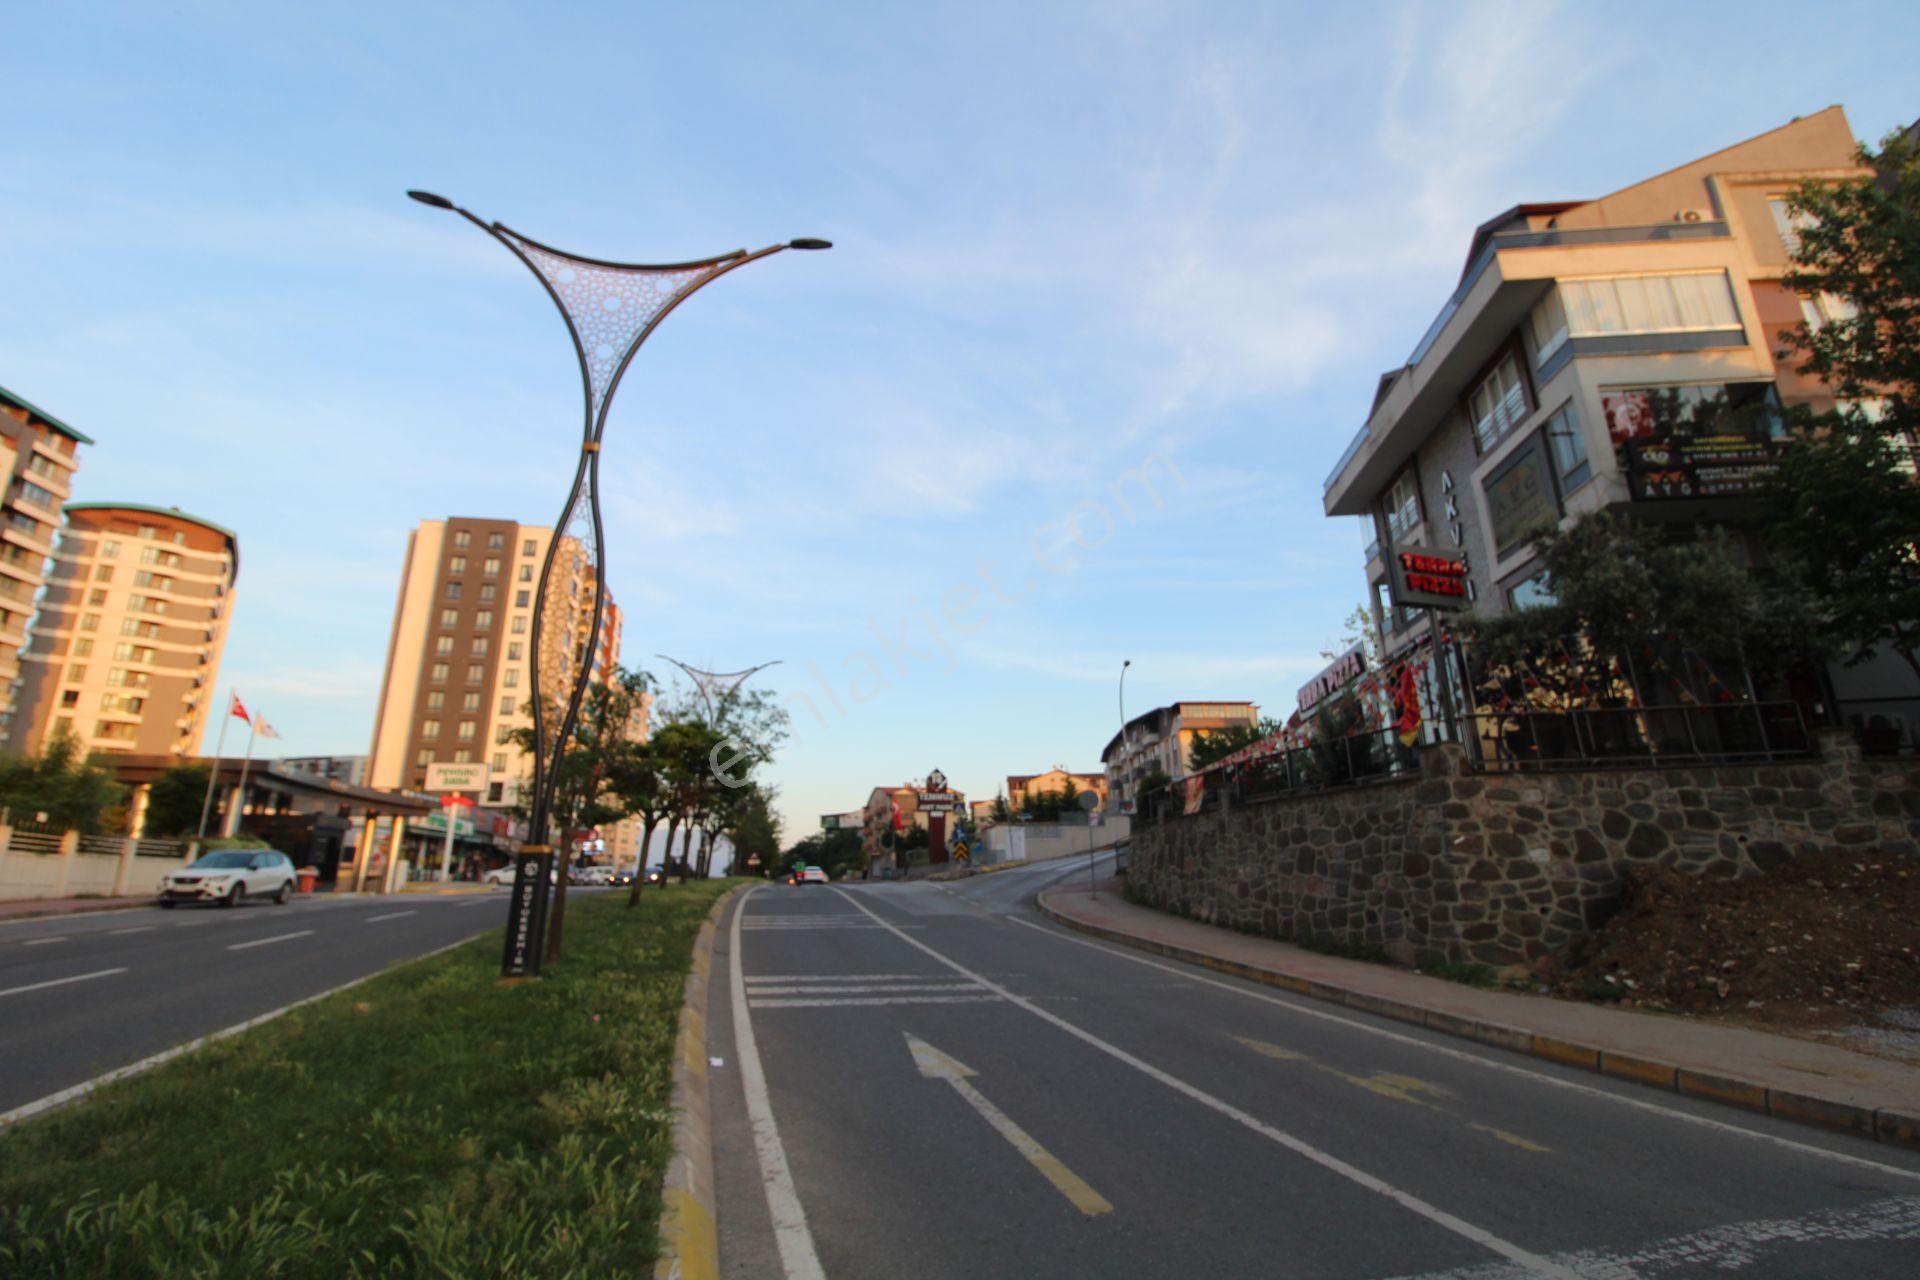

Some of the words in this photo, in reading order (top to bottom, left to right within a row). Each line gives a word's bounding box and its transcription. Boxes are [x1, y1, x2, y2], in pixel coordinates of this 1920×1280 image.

[1399, 551, 1469, 577] TERRA
[1406, 573, 1467, 597] PIZZA
[1327, 651, 1362, 693] PIZZA
